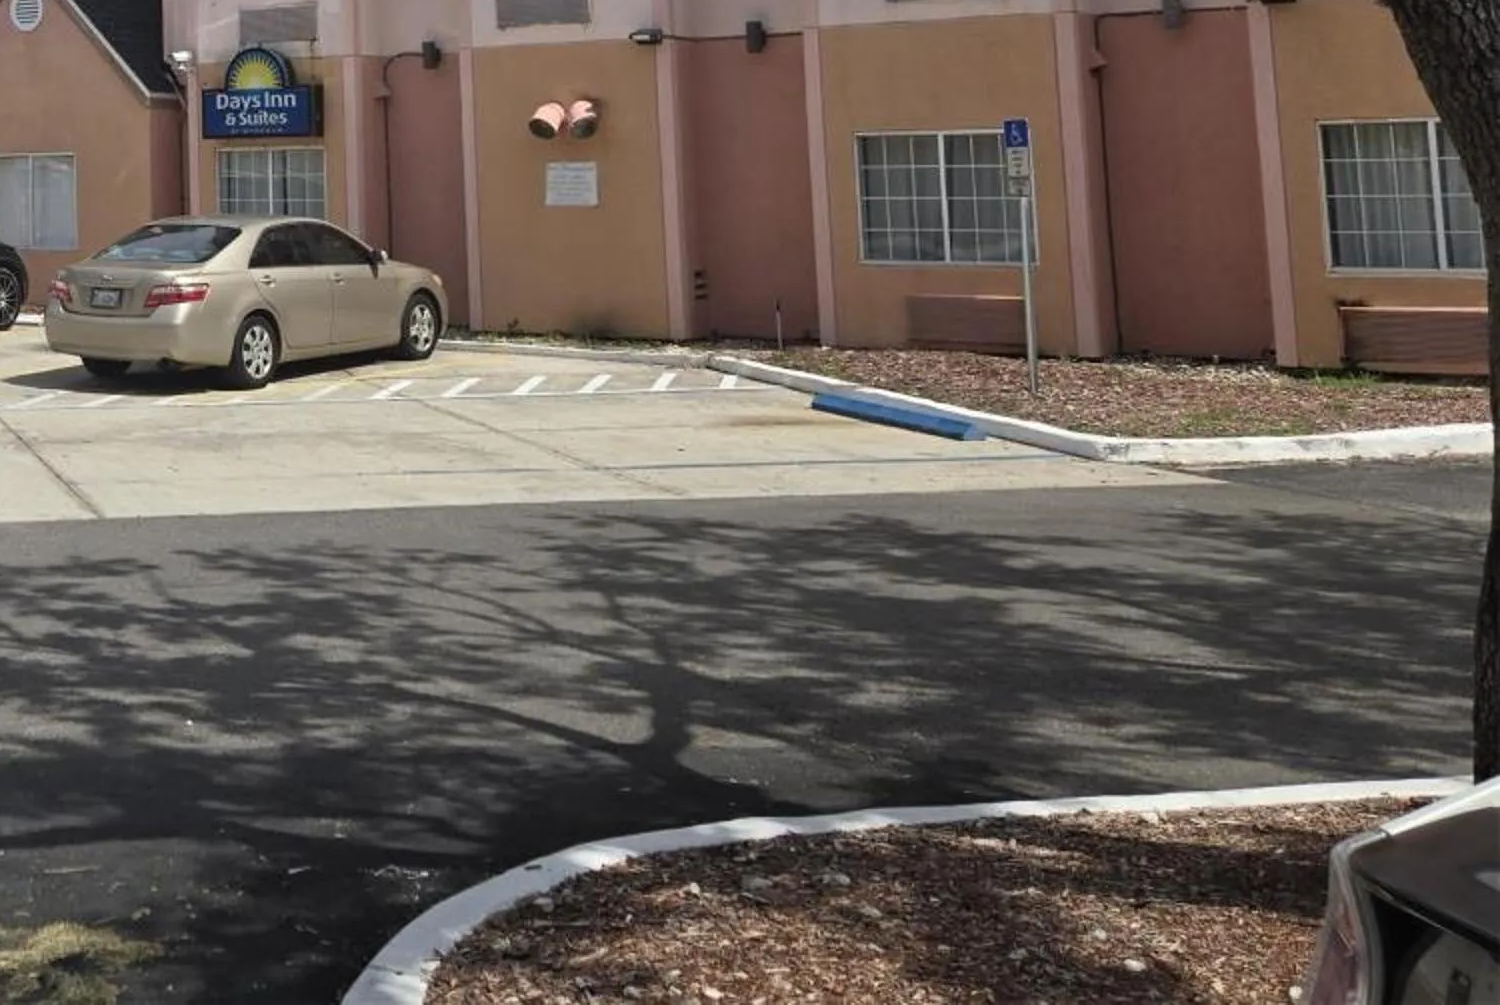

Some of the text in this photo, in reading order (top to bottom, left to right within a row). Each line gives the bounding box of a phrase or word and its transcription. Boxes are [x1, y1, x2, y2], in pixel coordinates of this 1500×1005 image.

[216, 91, 297, 113] Days Inn
[225, 110, 288, 126] & Suites
